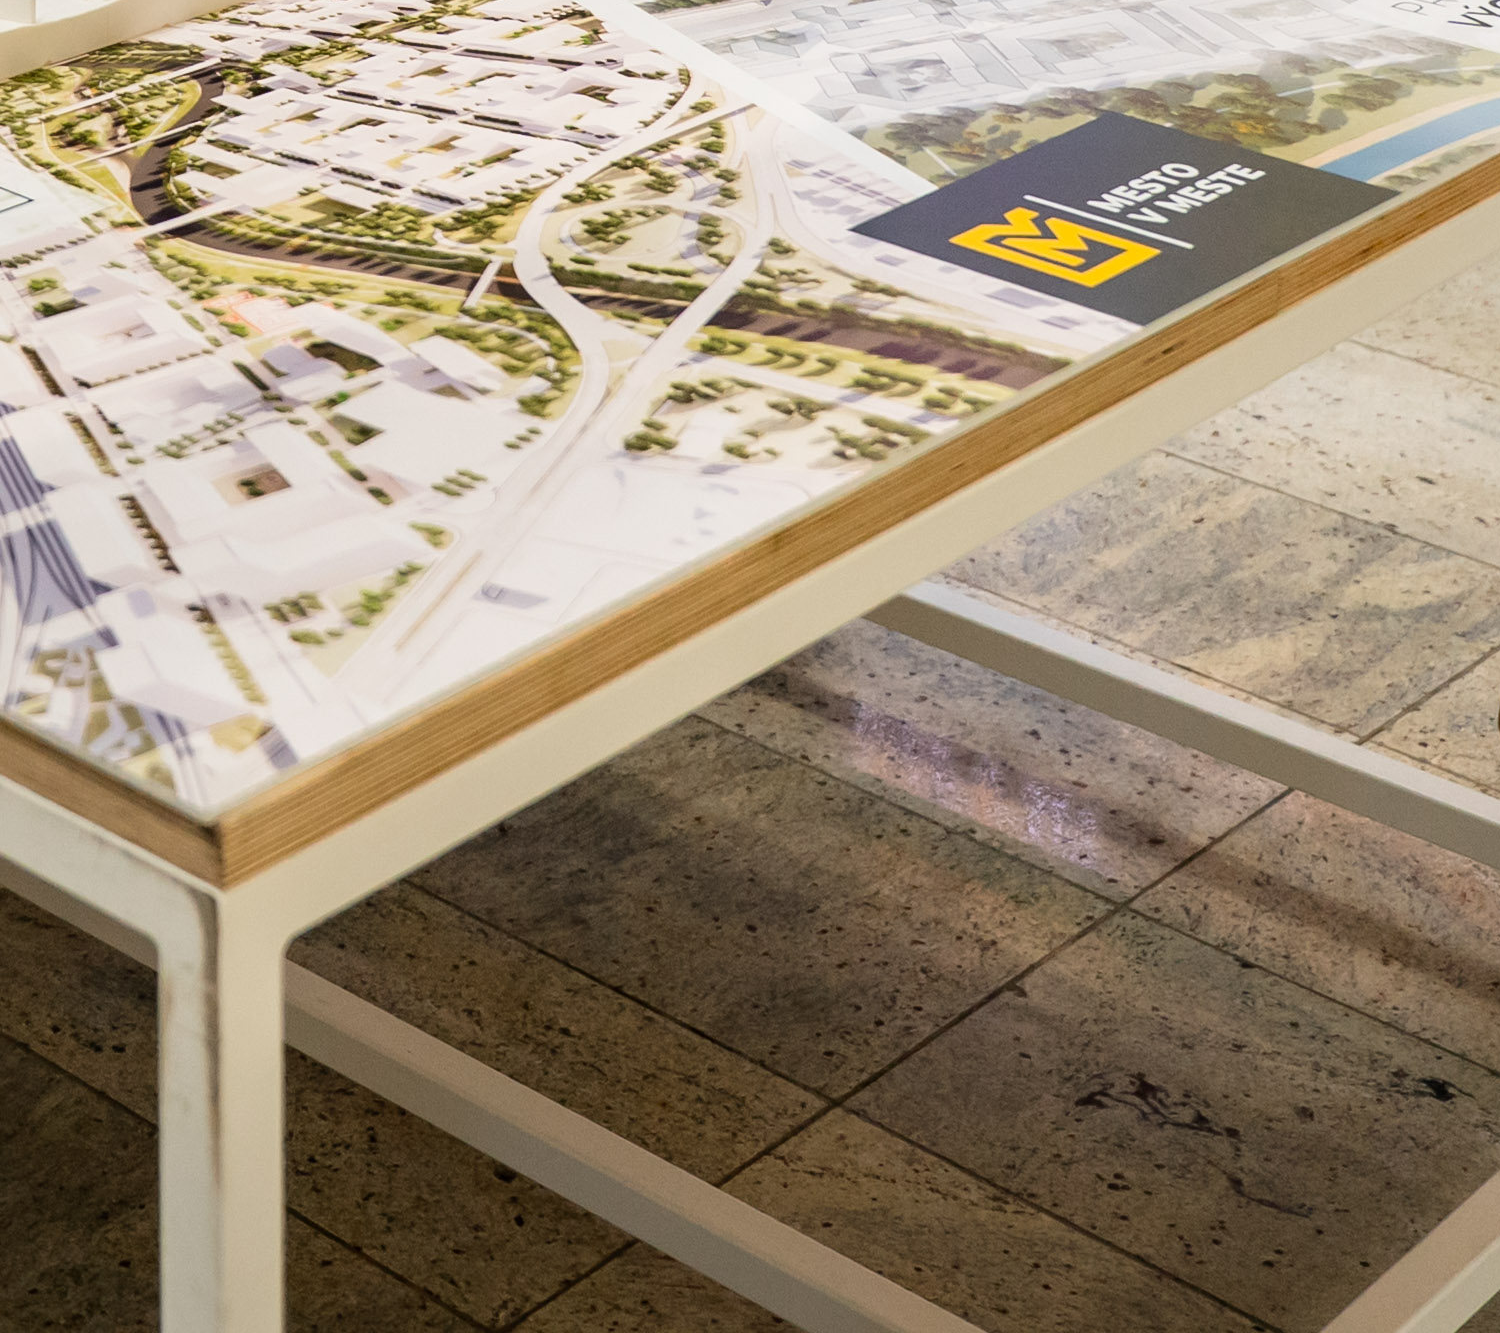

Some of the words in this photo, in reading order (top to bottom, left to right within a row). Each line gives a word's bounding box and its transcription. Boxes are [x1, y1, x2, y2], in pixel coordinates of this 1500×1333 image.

[1087, 162, 1200, 213] MESTO
[1126, 208, 1169, 225] V
[1153, 163, 1266, 214] MESTE
